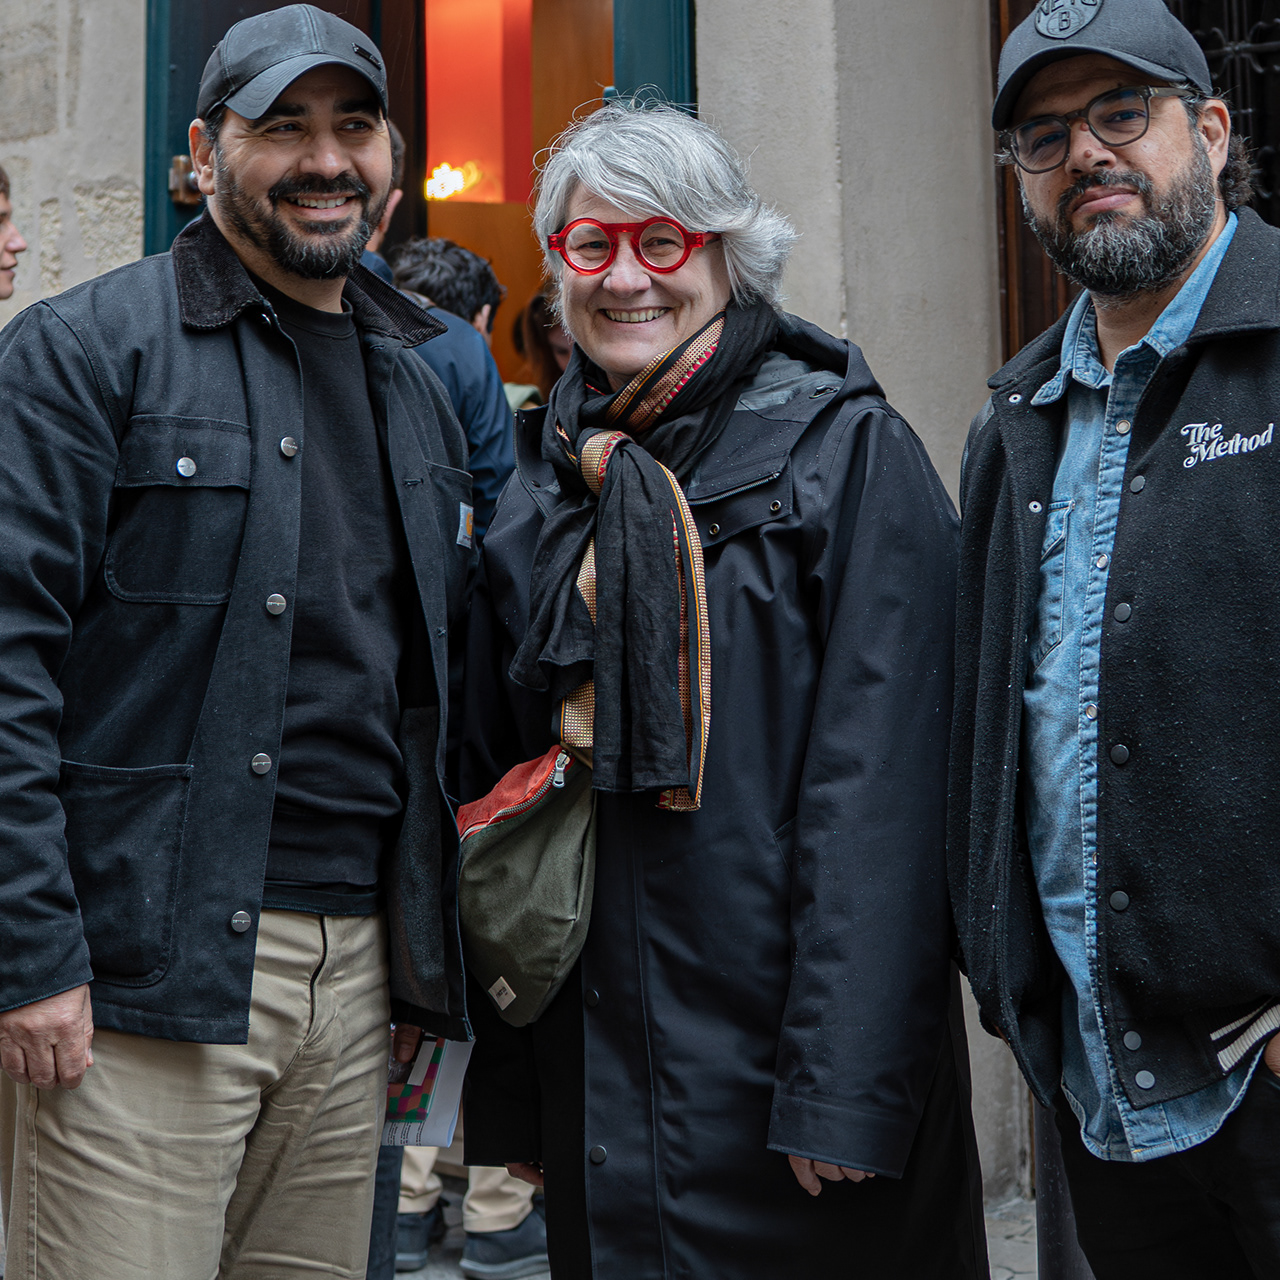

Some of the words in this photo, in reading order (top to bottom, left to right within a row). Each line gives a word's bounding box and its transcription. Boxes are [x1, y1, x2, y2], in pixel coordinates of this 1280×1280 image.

[1059, 11, 1070, 31] B
[1180, 422, 1222, 446] The
[1183, 423, 1274, 468] Method
